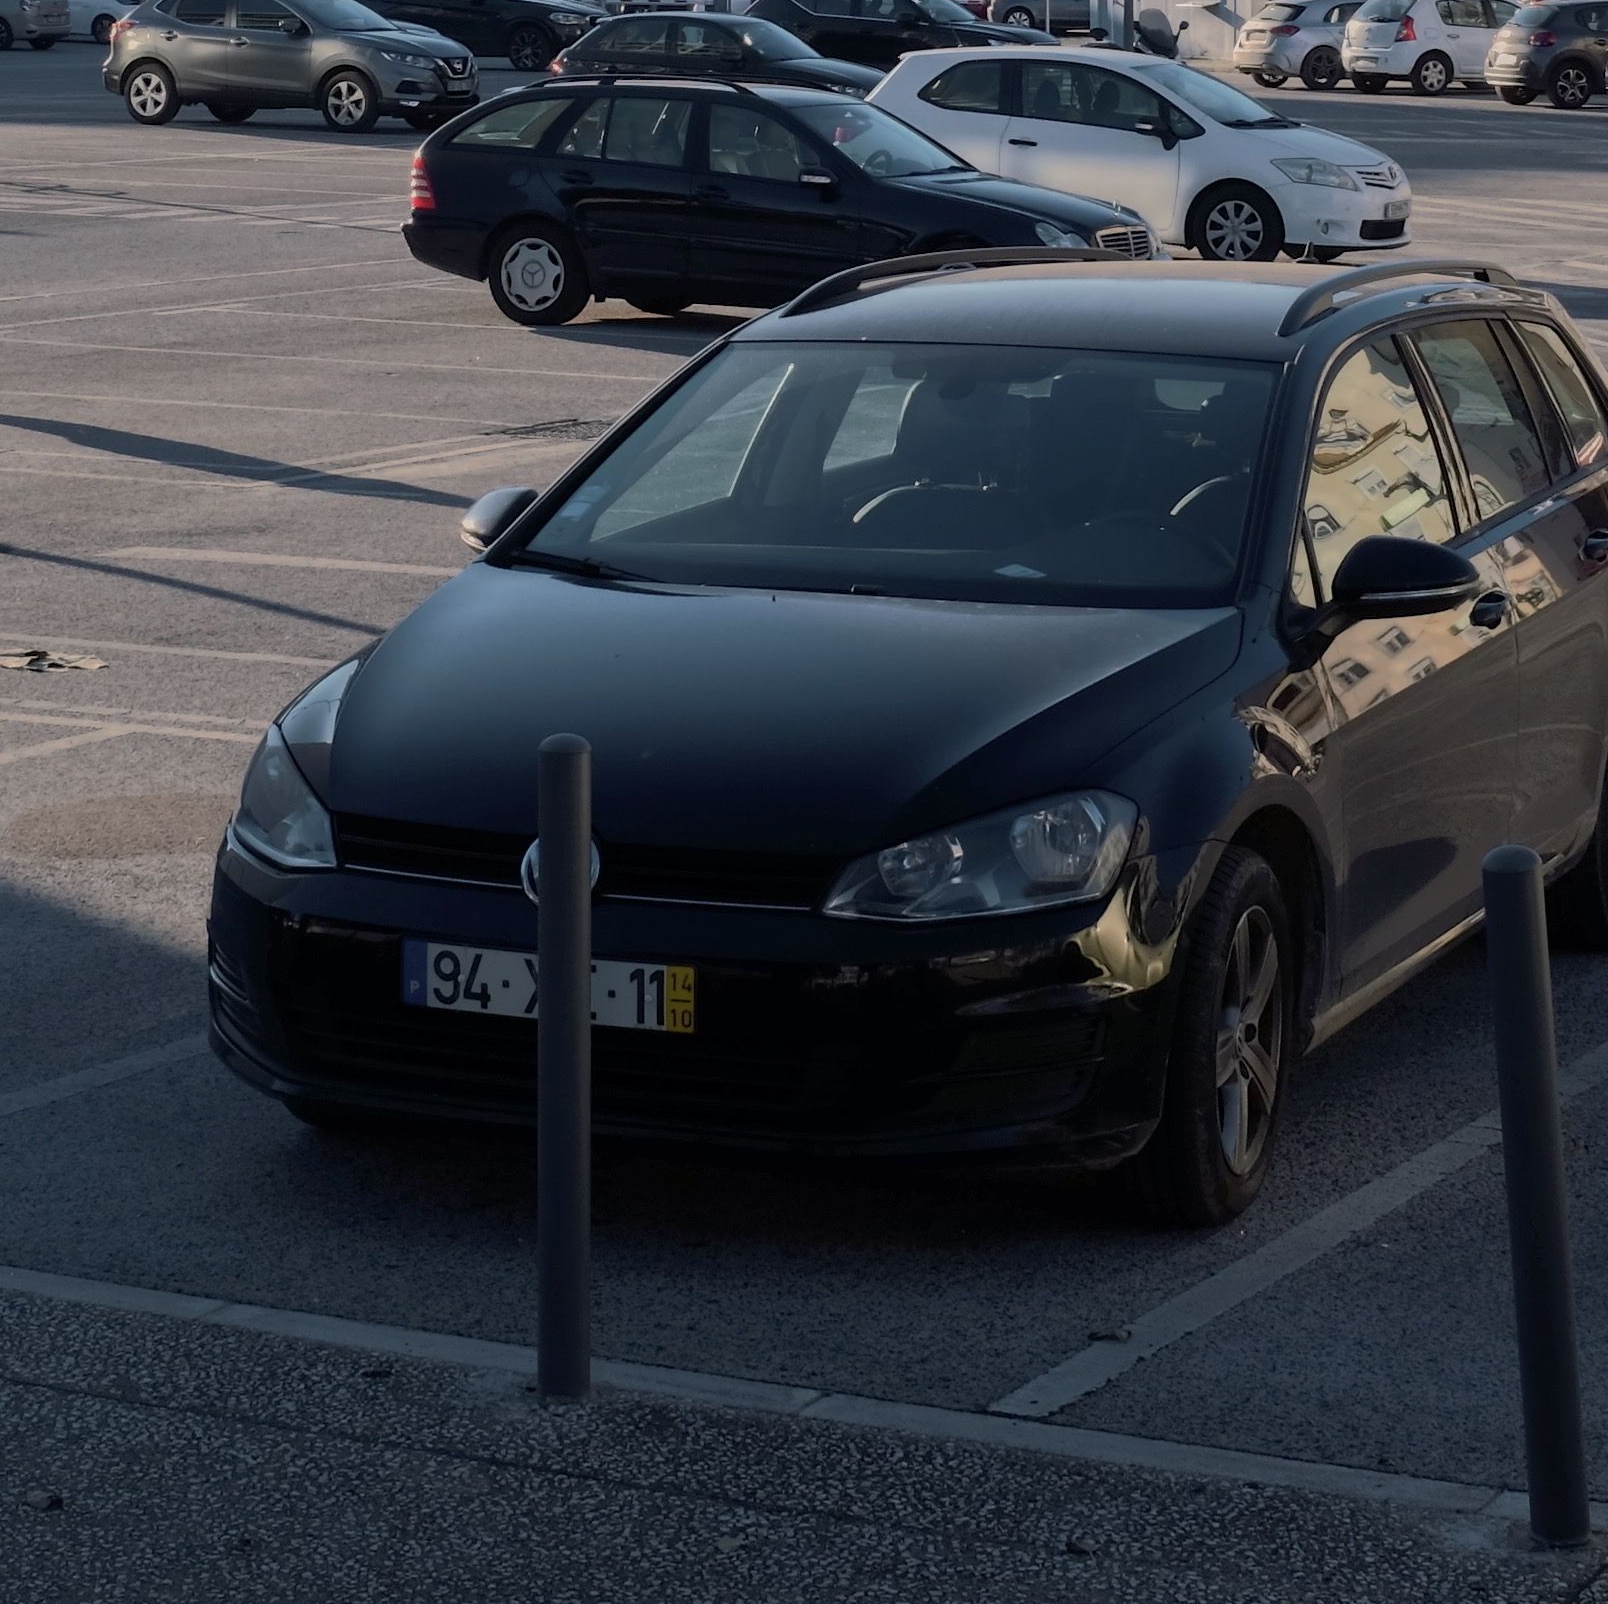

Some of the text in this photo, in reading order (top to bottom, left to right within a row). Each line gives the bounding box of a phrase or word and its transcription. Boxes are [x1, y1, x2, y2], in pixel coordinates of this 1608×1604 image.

[409, 979, 421, 993] P
[670, 972, 693, 993] 14
[670, 1008, 693, 1029] 10
